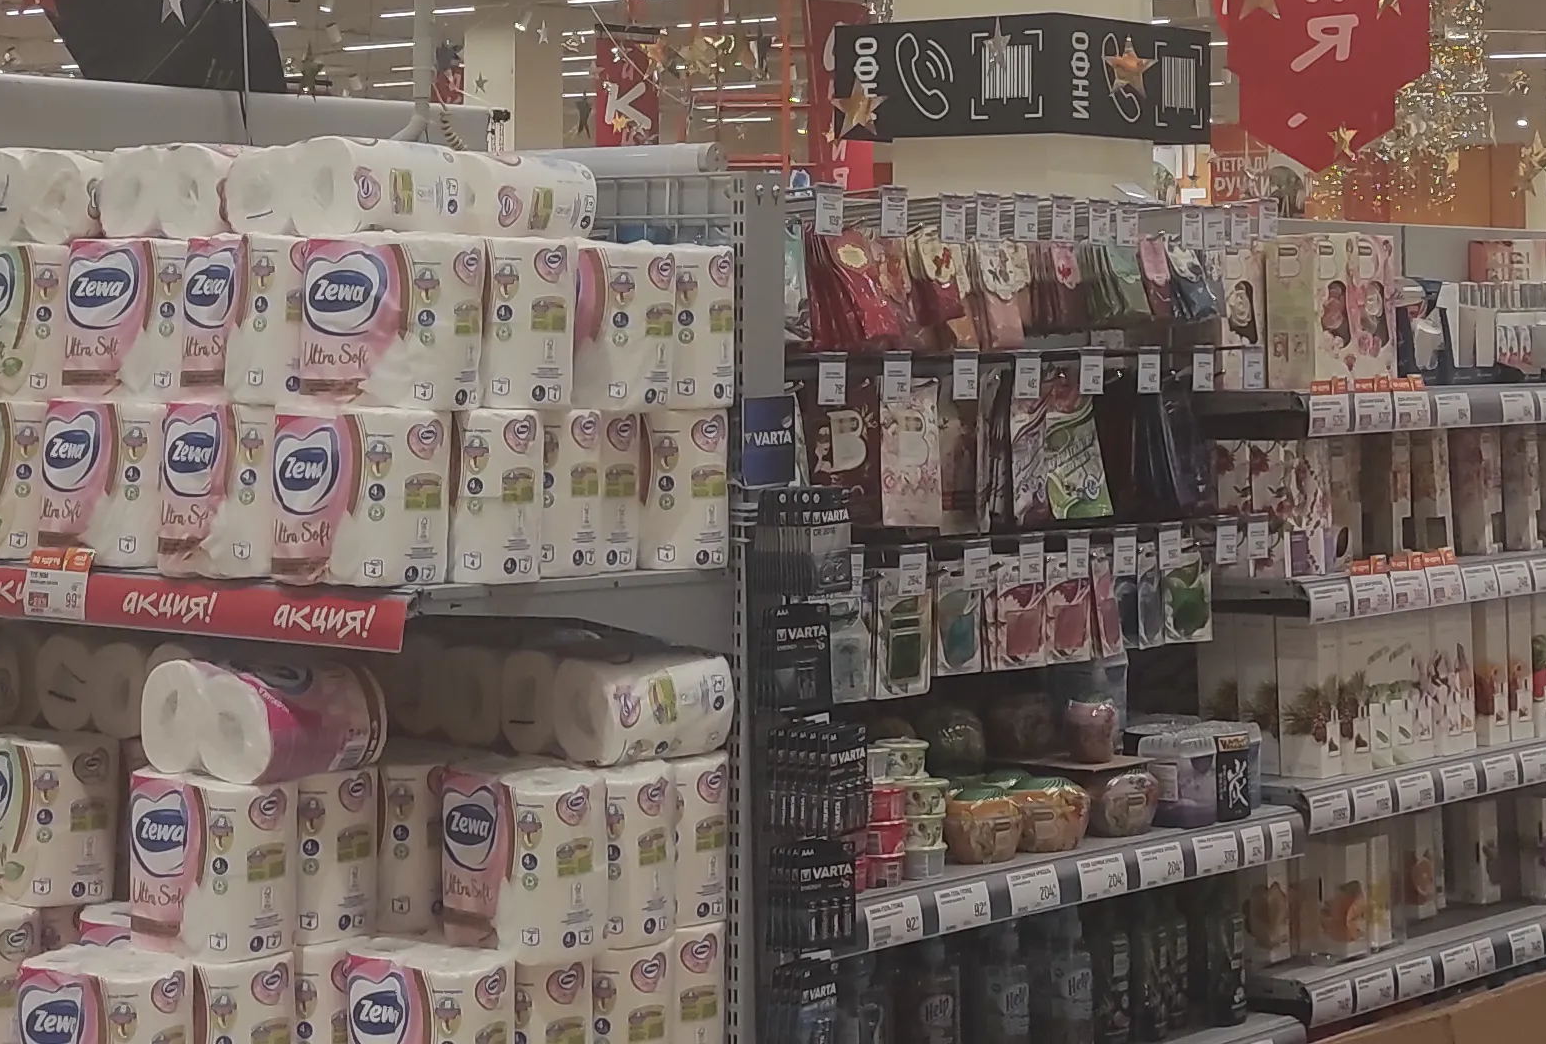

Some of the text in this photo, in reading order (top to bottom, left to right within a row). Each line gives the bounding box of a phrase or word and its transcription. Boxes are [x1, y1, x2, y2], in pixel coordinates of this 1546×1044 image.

[1072, 31, 1090, 120] ИНФО
[1214, 156, 1269, 173] ТЕТРДИ
[75, 277, 124, 297] Zewa
[315, 279, 365, 303] Zewa
[65, 335, 93, 358] Ultra
[304, 341, 369, 370] Ultra Soft
[50, 438, 88, 459] Zewa
[754, 430, 792, 446] VARTA
[172, 440, 213, 464] Zewa
[161, 503, 186, 526] Ultra
[821, 508, 849, 523] VARTA
[274, 519, 330, 548] Ultra Soft
[122, 591, 218, 624] акция!
[776, 609, 789, 617] AAA
[273, 605, 376, 638] акция!
[788, 625, 827, 640] VARTA
[838, 747, 865, 763] VARTA
[141, 818, 185, 843] Zewa
[450, 812, 490, 838] Zewa
[813, 863, 853, 879] VARTA
[158, 884, 184, 909] Sof
[809, 982, 836, 1000] VARTA
[359, 1000, 399, 1025] Zew
